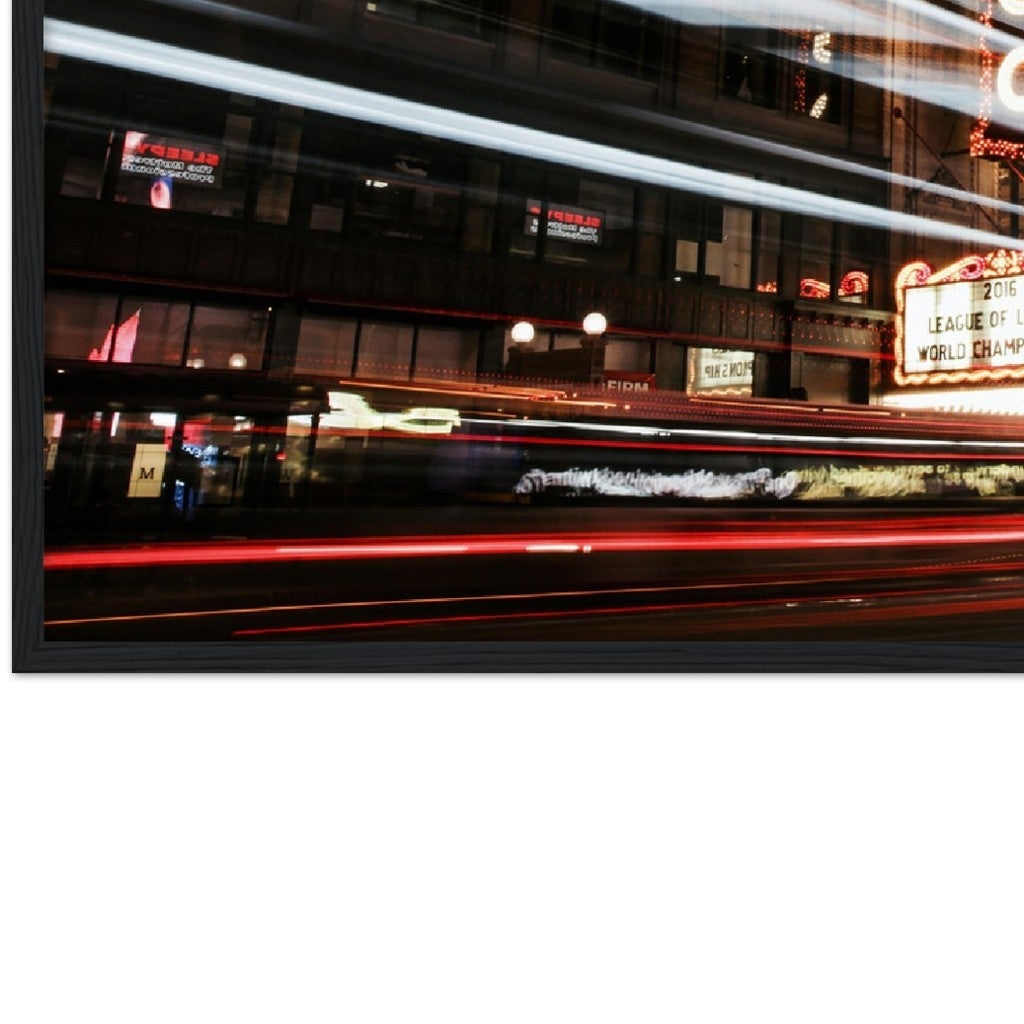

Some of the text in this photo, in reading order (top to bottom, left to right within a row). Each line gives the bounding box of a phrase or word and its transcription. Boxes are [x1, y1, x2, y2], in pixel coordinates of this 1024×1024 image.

[983, 280, 1017, 300] 2016
[928, 311, 984, 334] LEAGUE
[989, 310, 1008, 328] OF
[917, 342, 966, 362] WORLD
[139, 467, 155, 480] M
